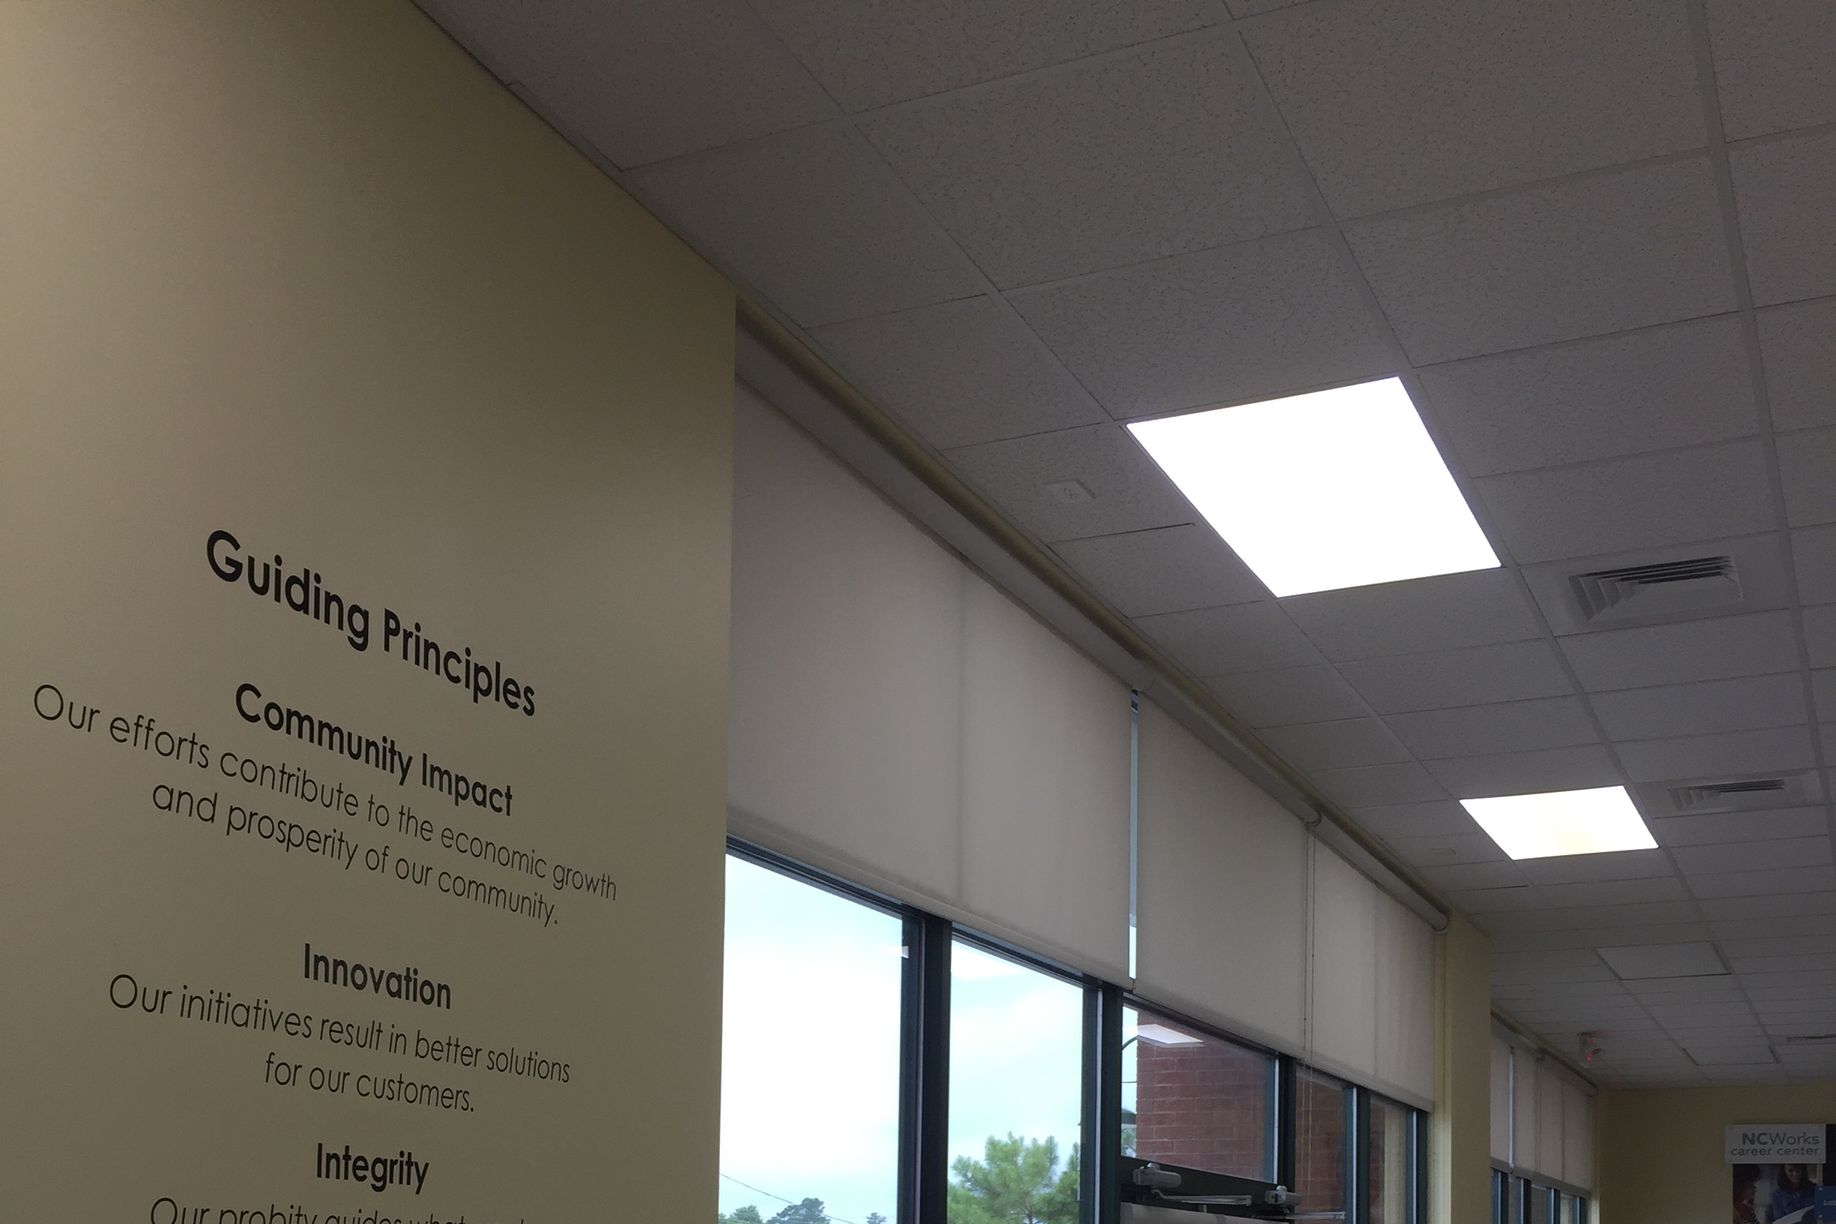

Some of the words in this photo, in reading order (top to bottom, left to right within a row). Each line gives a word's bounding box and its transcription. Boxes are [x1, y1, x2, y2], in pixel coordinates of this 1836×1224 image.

[207, 529, 370, 653] Guiding
[383, 608, 536, 717] Principles
[34, 684, 101, 733] Our
[109, 715, 210, 769] efforts
[219, 753, 359, 817] contribute
[367, 793, 390, 827] to
[398, 805, 434, 842] the
[440, 828, 548, 879] economic
[552, 864, 617, 901] growth
[235, 683, 413, 786] Community
[422, 753, 513, 817] Impact
[152, 785, 219, 824] and
[225, 804, 359, 870] prosperity
[365, 844, 390, 874] of
[395, 857, 434, 887] our
[438, 871, 558, 928] community.
[304, 942, 452, 1010] Innovation
[109, 974, 173, 1015] Our
[180, 984, 313, 1039] initiatives
[319, 1018, 384, 1051] result
[388, 1024, 407, 1056] in
[414, 1029, 483, 1068] better
[486, 1047, 570, 1084] solutions
[264, 1051, 303, 1087] for
[308, 1067, 351, 1094] our
[356, 1072, 475, 1113] customers.
[316, 1142, 430, 1196] Integrity
[1731, 1146, 1772, 1157] career
[1776, 1147, 1819, 1157] center
[1742, 1132, 1820, 1146] NCWorks
